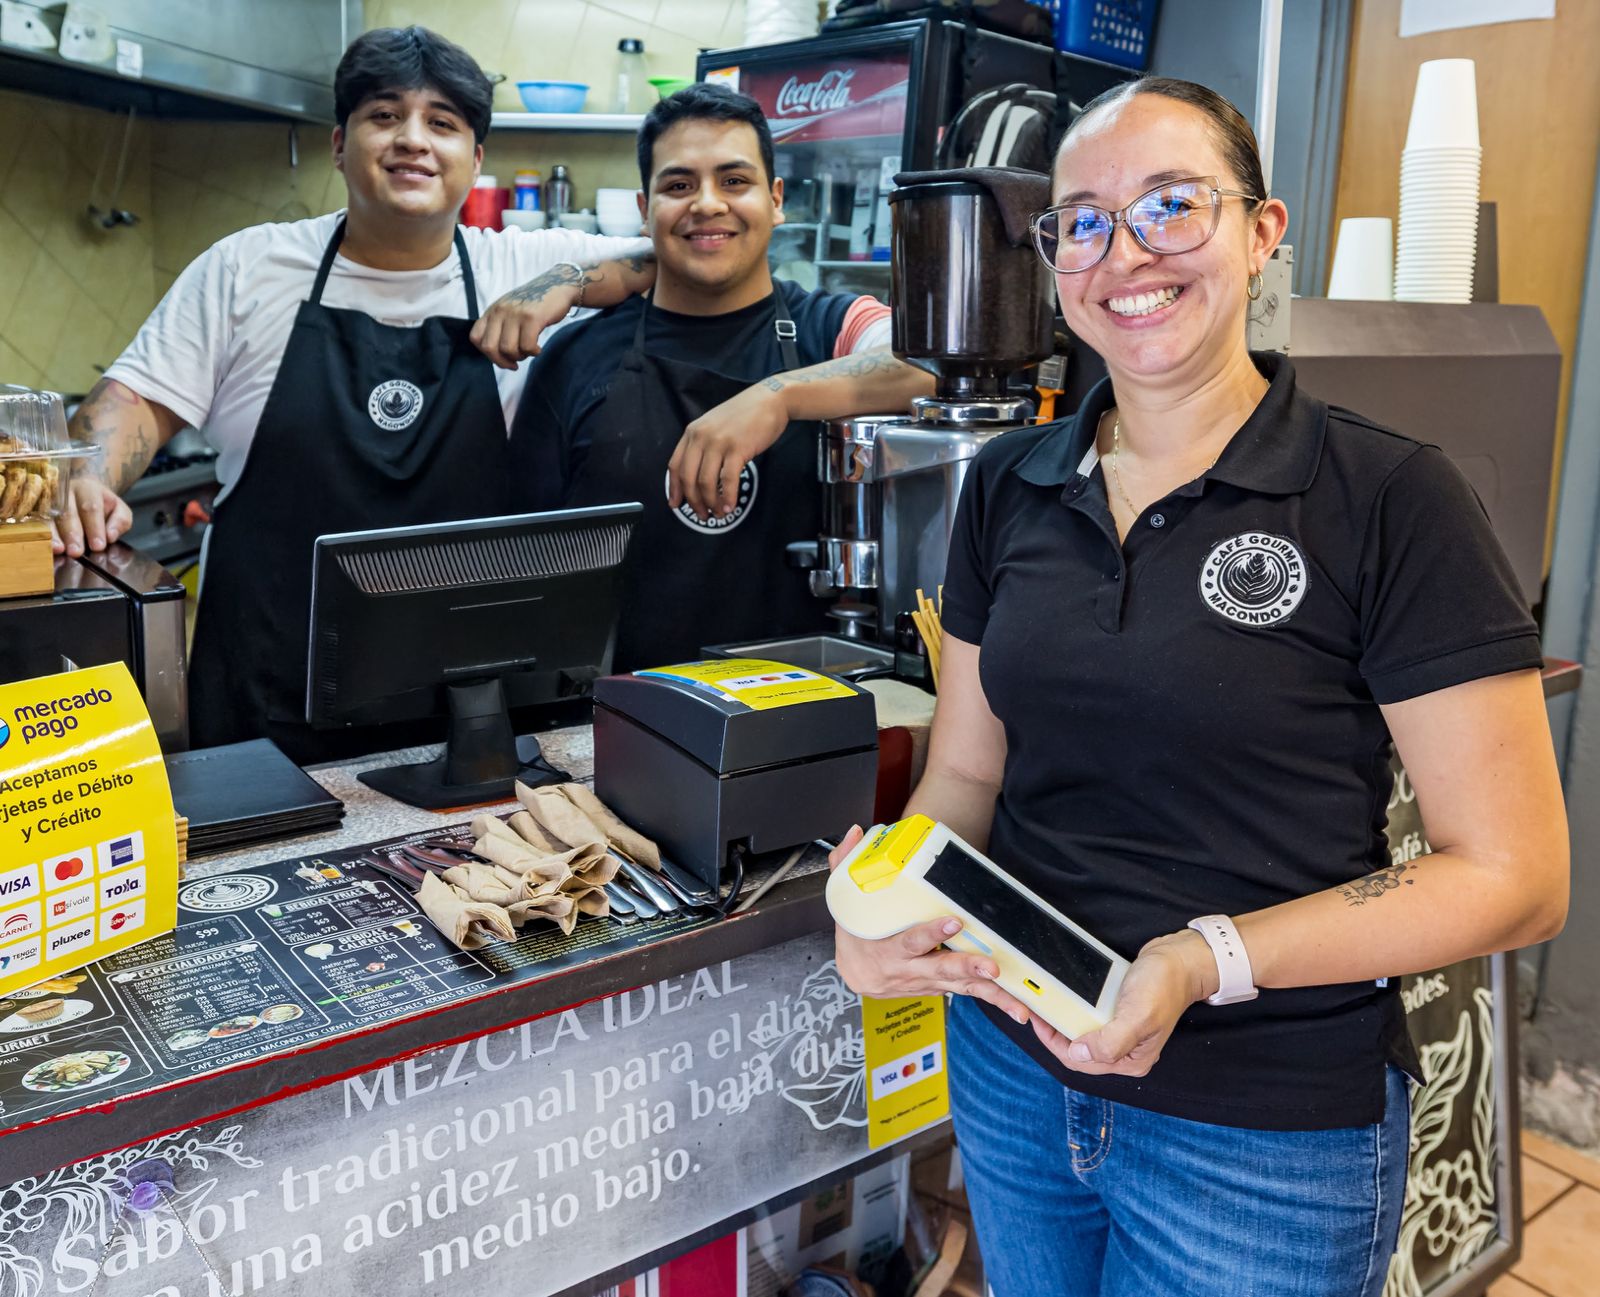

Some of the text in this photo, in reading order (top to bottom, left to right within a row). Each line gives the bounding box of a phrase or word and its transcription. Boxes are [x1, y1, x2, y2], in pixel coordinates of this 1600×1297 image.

[1249, 535, 1300, 581] GOURMET
[1208, 592, 1281, 623] MACONDO
[14, 688, 112, 722] mercado
[21, 715, 78, 744] pago
[0, 760, 97, 794] Aceptamos
[0, 774, 133, 823] jetas de Débito
[21, 807, 101, 843] y Crédito
[1392, 831, 1422, 865] afé
[0, 876, 31, 896] VISA
[284, 895, 332, 911] BEBIDAS
[0, 923, 33, 939] CARNET
[52, 928, 91, 950] pluxee
[196, 928, 219, 939] $99
[320, 925, 337, 933] $70
[337, 927, 386, 944] BEBIDAS
[338, 932, 397, 951] CALIENTES
[184, 940, 207, 948] QUESOS
[380, 953, 398, 961] $40
[137, 946, 236, 979] ESPECIALIDADES
[151, 992, 192, 1006] PECHUGA
[208, 979, 238, 991] GUSTO
[263, 983, 279, 991] $114
[1400, 972, 1450, 1014] ades.
[876, 1006, 935, 1036] Tarjetas de Débito
[885, 1001, 922, 1020] Aceptamos
[215, 1048, 257, 1064] GOURMET
[260, 1035, 303, 1051] MACONDO
[320, 1021, 354, 1033] CUENTA
[355, 1015, 374, 1024] CON
[375, 1001, 423, 1018] SUCURSALES
[421, 990, 455, 1004] ADEMÁS
[345, 1009, 589, 1118] MEZCLA
[603, 959, 748, 1033] IDEAL
[891, 1024, 921, 1043] y Crédito
[0, 1033, 50, 1053] URMET
[880, 1072, 898, 1086] VISA
[57, 1189, 260, 1293] Sabor
[280, 1070, 577, 1213] tradicional
[590, 1041, 693, 1101] para
[708, 1013, 743, 1060] el
[202, 1232, 322, 1297] una
[343, 1154, 519, 1254] acidez
[534, 1099, 676, 1179] media
[418, 1148, 701, 1284] medio bajo.
